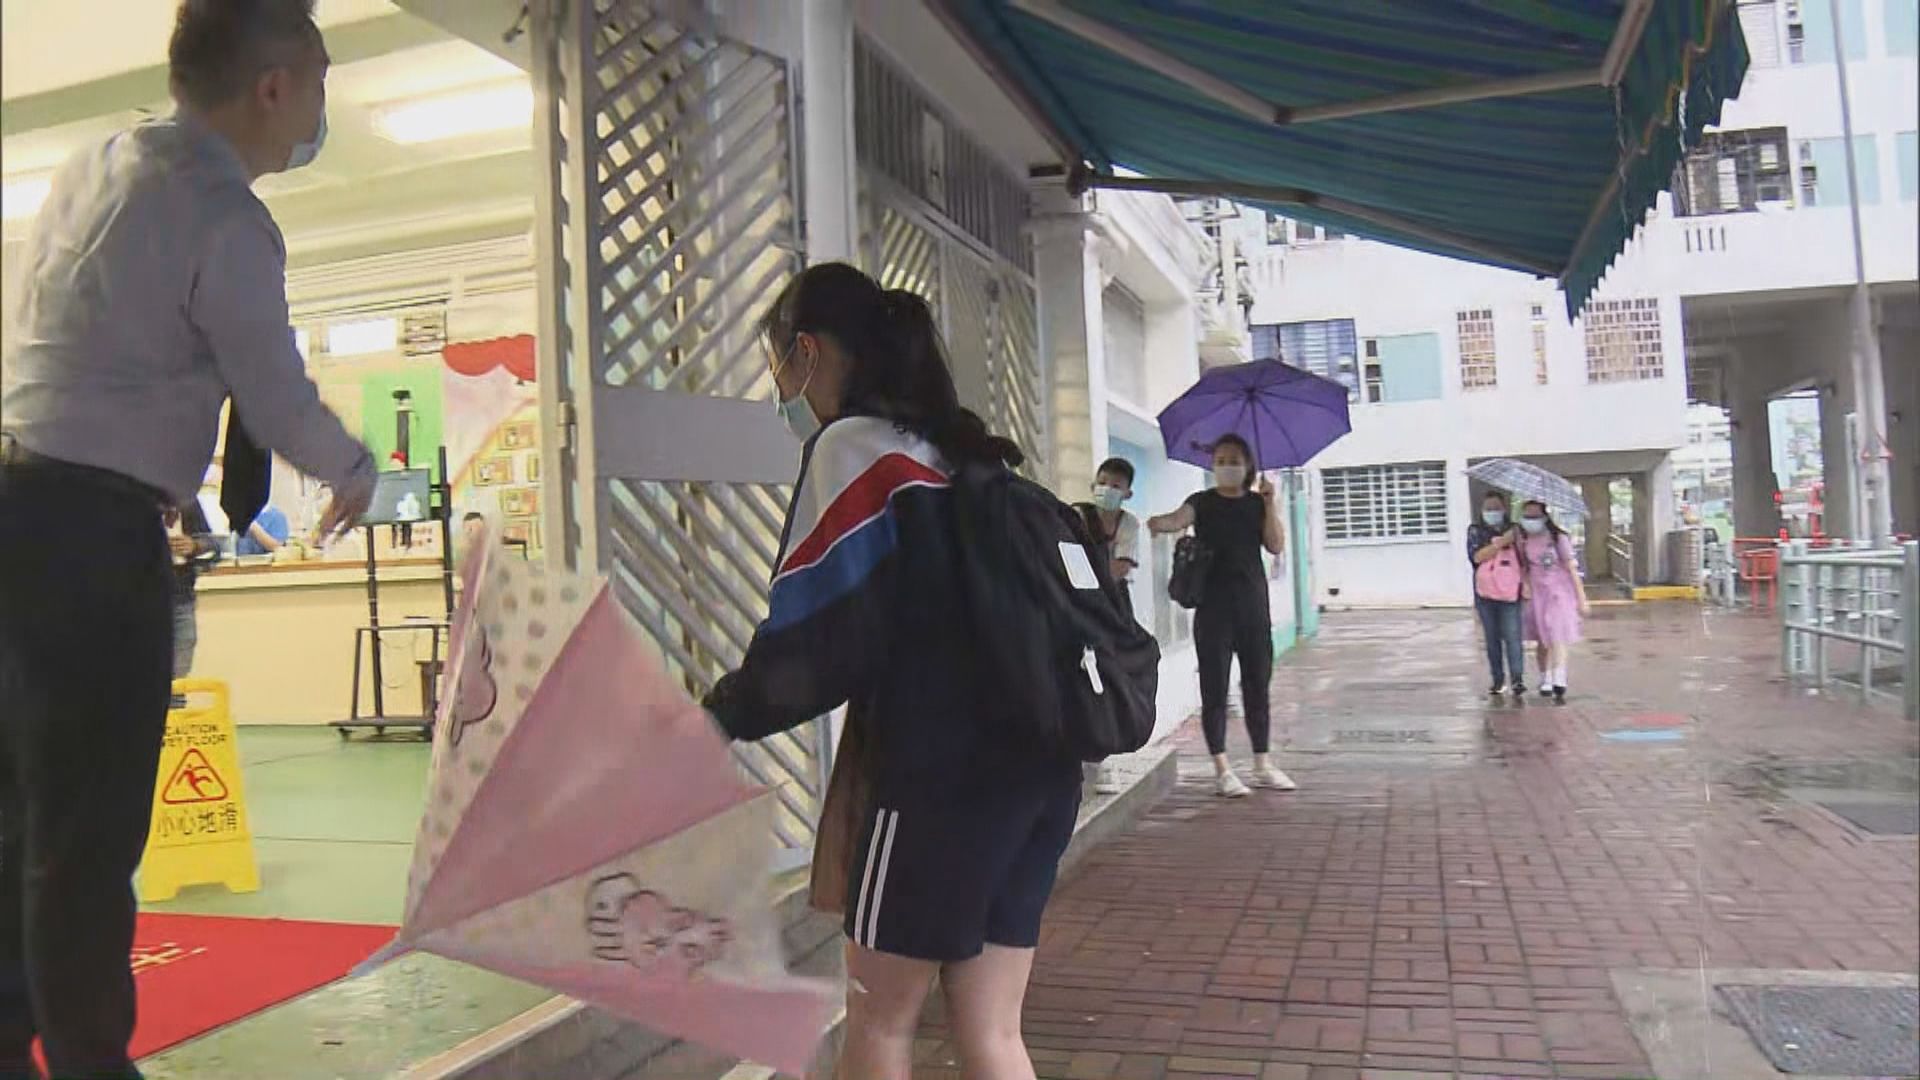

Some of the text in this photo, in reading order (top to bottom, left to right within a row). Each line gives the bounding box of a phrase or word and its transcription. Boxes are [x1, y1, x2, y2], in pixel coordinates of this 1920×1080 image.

[187, 733, 227, 747] FLOOR
[157, 802, 237, 837] 小心地滑
